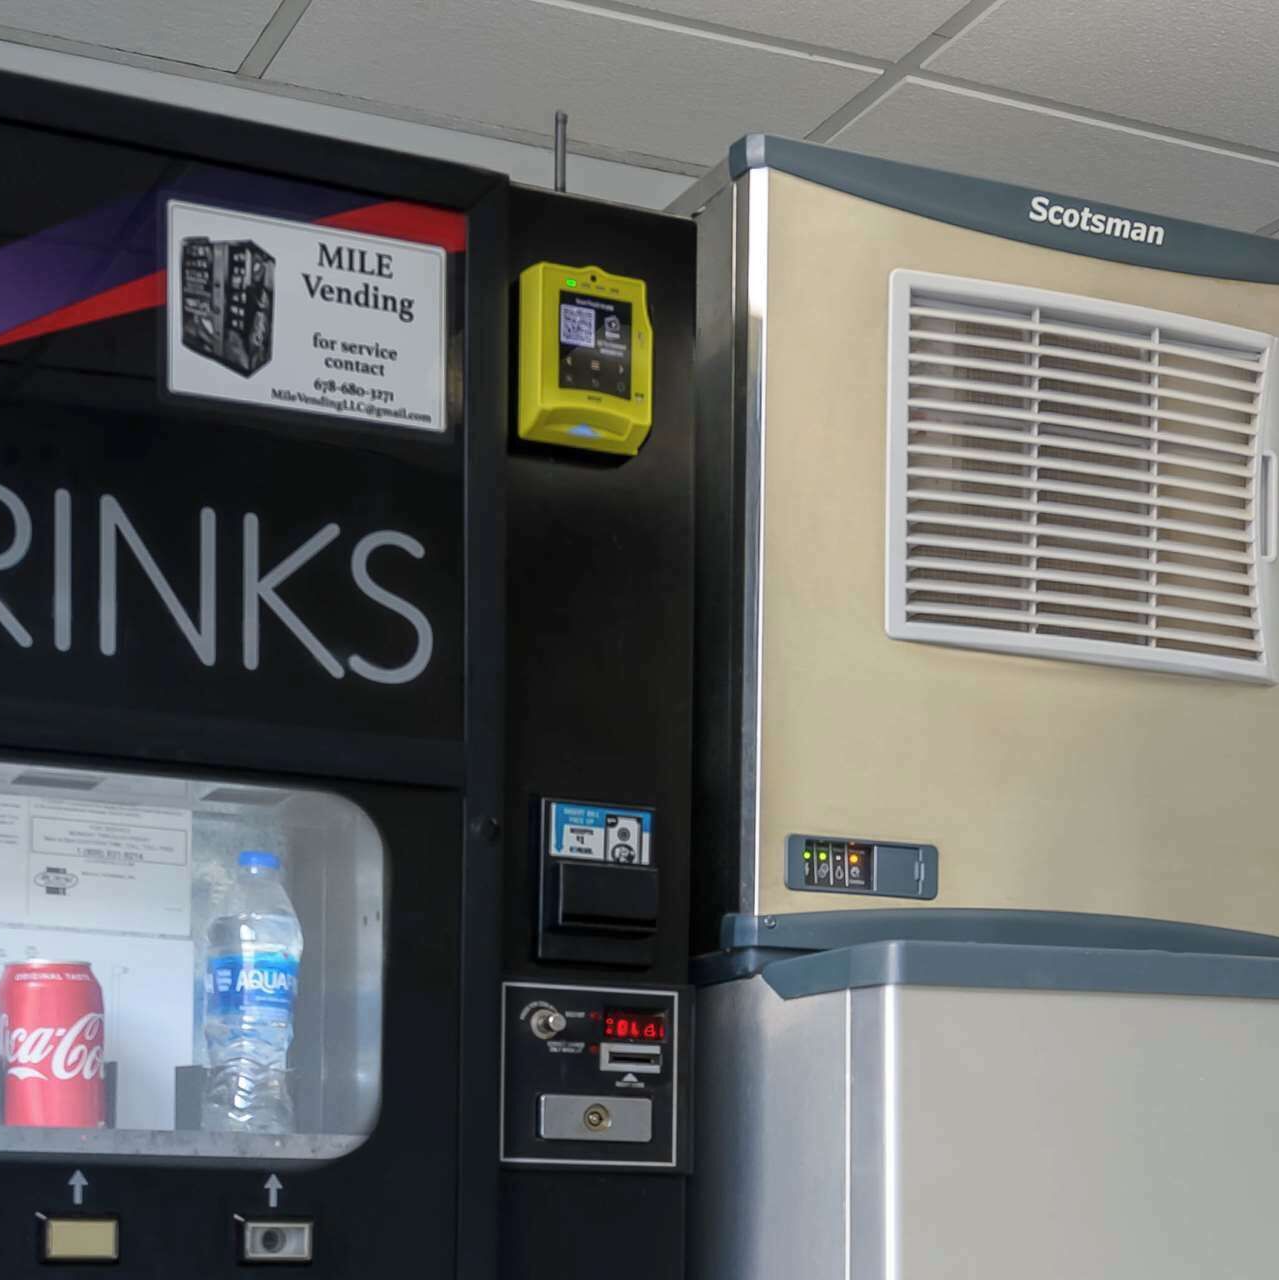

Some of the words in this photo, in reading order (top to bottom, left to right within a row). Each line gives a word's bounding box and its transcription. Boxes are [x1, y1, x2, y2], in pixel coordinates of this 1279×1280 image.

[1028, 196, 1166, 246] Scotsman
[318, 243, 393, 279] MILE
[302, 273, 414, 323] Vending
[313, 332, 337, 351] for
[341, 343, 397, 361] service
[324, 357, 385, 376] contact
